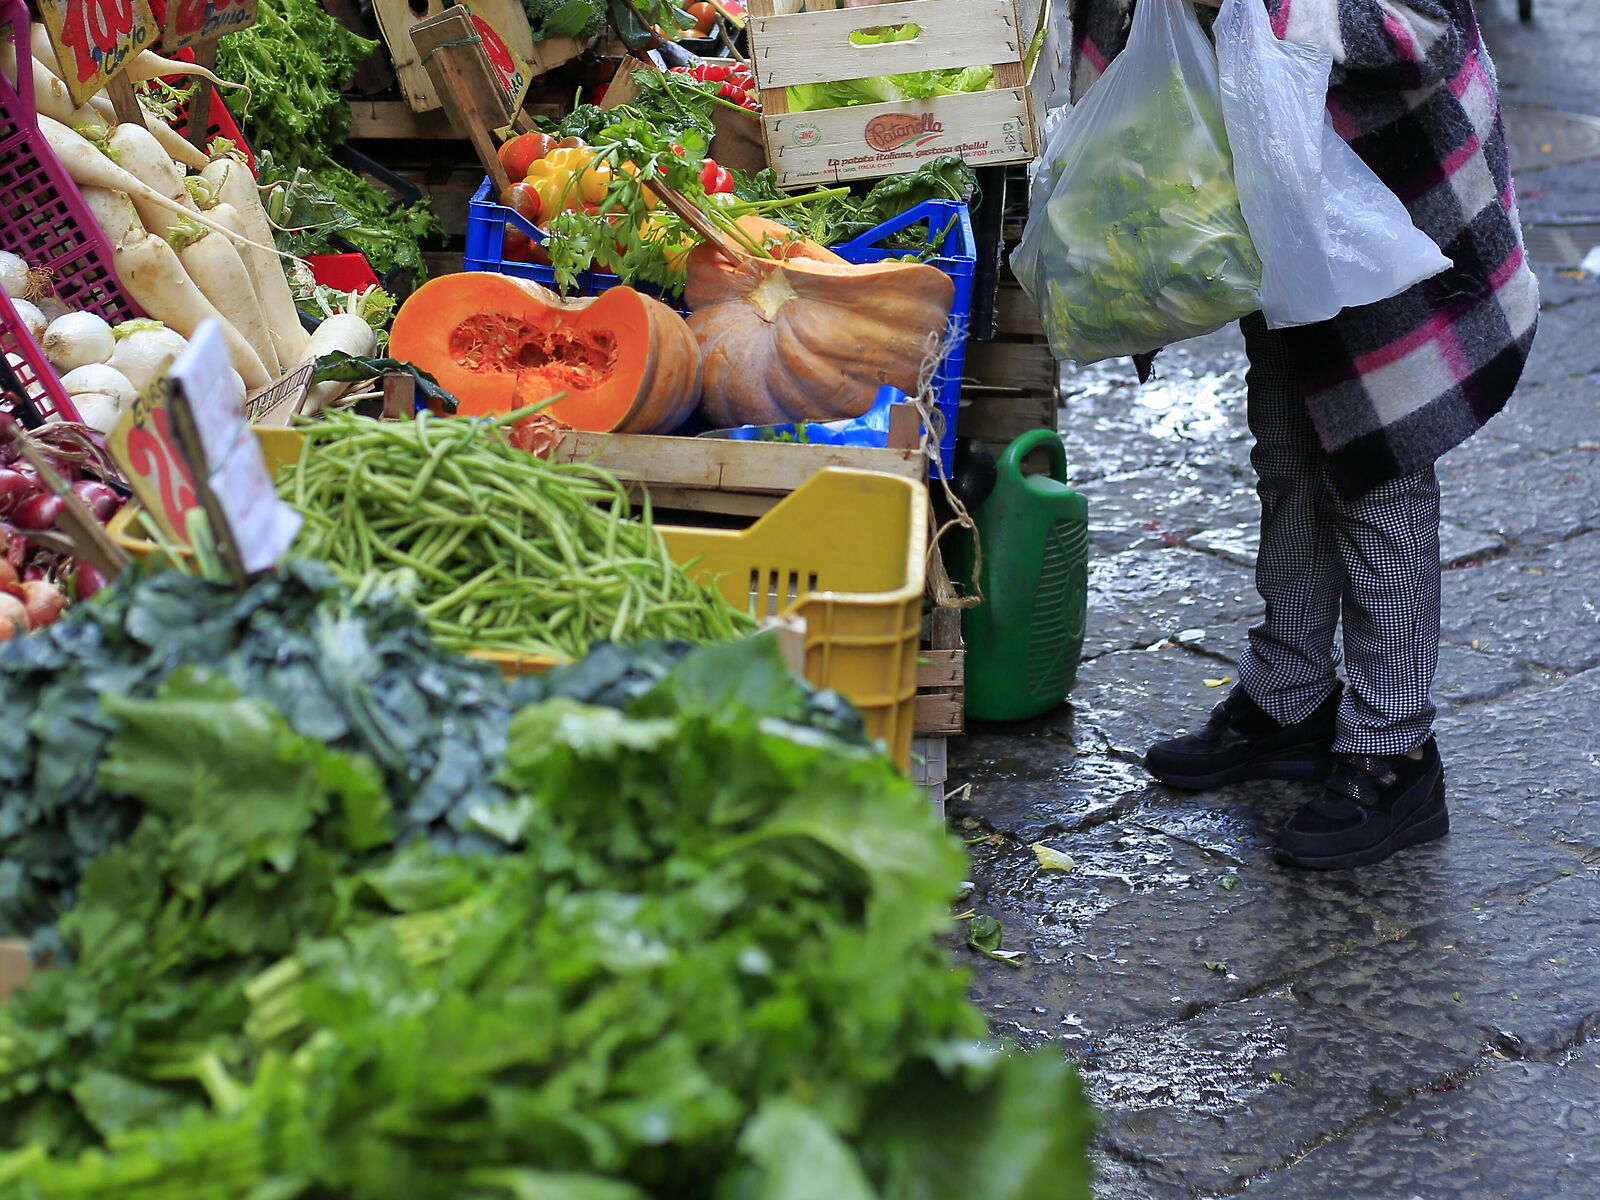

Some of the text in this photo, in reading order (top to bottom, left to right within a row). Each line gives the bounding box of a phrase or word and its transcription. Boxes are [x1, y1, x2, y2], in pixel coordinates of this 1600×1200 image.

[867, 112, 944, 146] Patanella
[827, 158, 841, 167] La
[841, 154, 874, 167] patata
[876, 148, 914, 161] italiana,
[915, 145, 953, 158] gustosa
[961, 140, 989, 151] bella!
